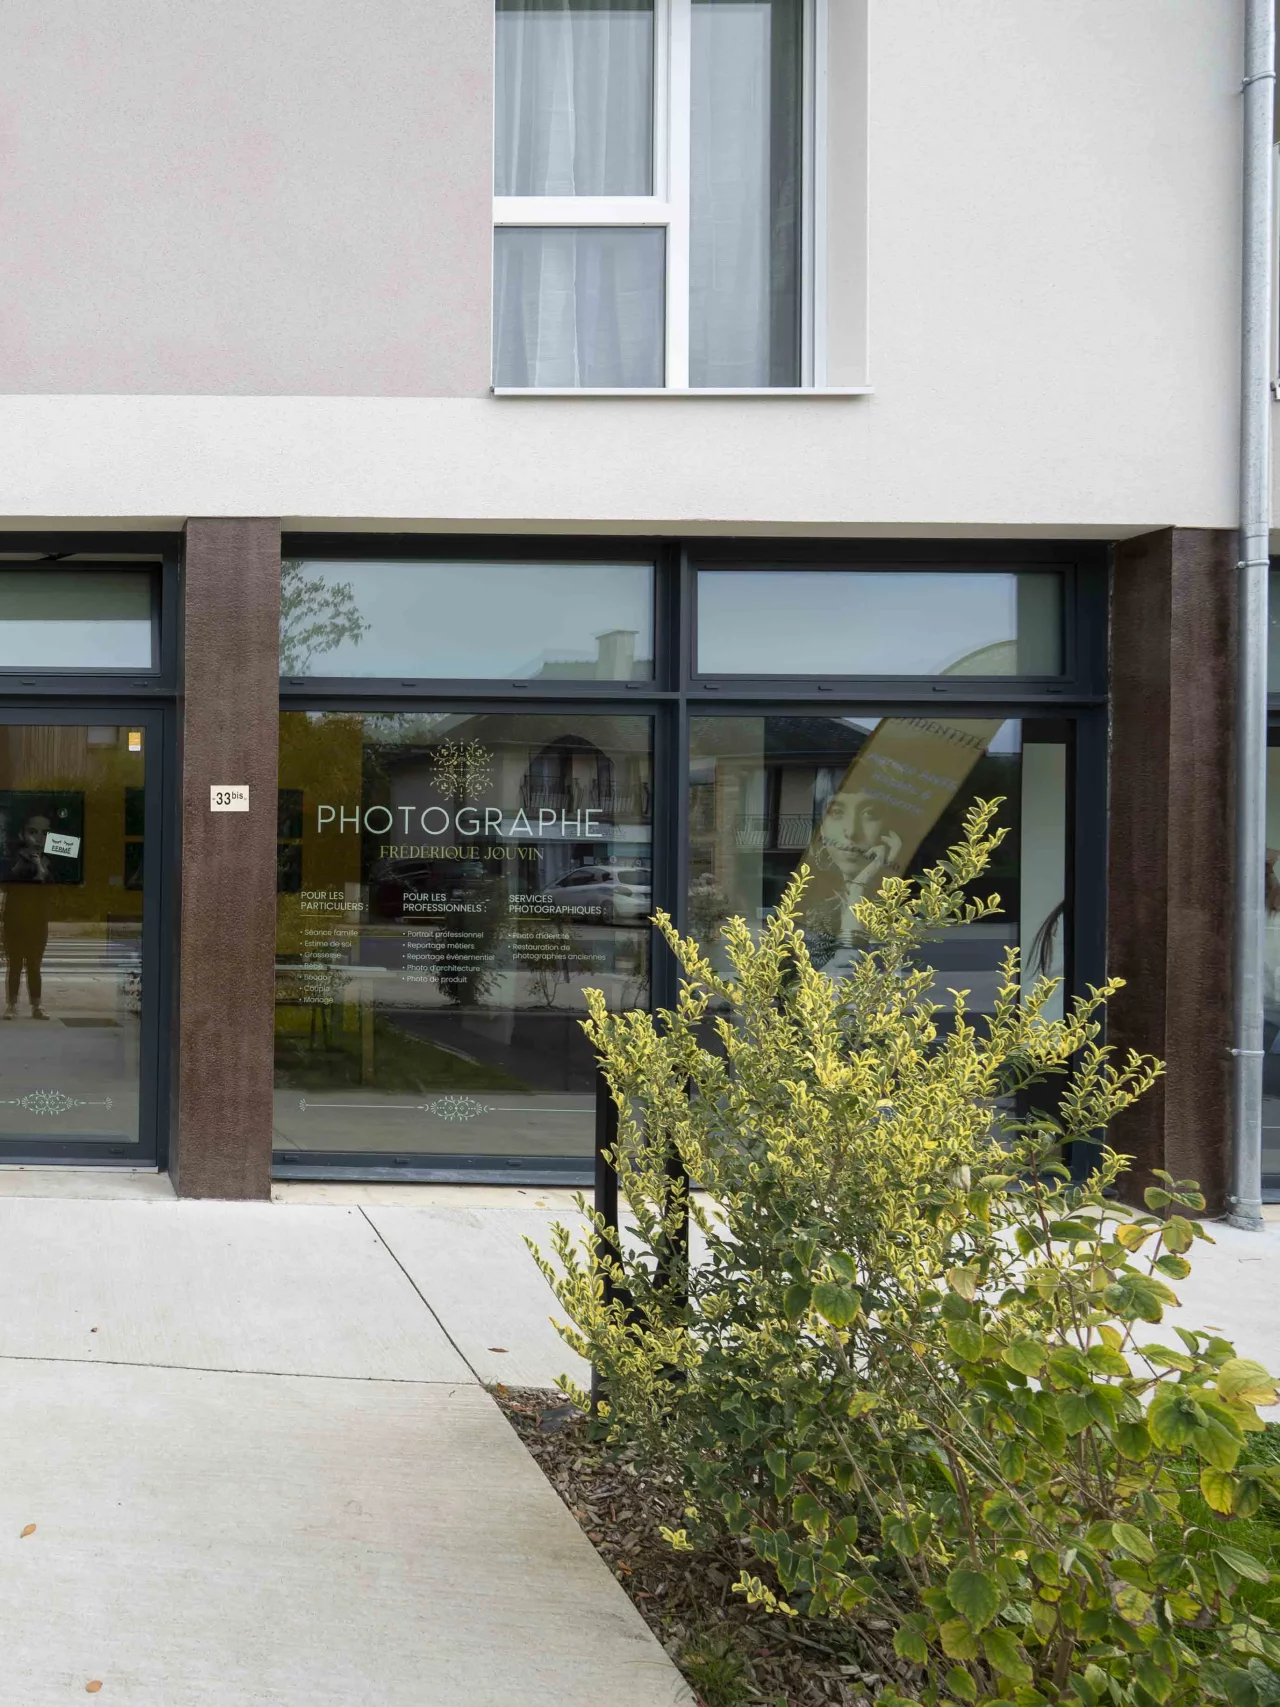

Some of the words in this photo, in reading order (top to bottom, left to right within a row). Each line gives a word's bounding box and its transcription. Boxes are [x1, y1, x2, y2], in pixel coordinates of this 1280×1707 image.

[317, 805, 603, 837] PHOTOGRAPHE
[379, 844, 481, 862] FRÉDÉRIQUE
[483, 847, 545, 861] JOUVIN
[300, 891, 327, 900] POUR
[329, 891, 345, 900] LES
[403, 892, 429, 901] POUR
[431, 893, 447, 902] LES
[509, 894, 553, 903] SERVICES
[300, 902, 364, 911] PARTICULIERS
[403, 903, 482, 913] PROFESSIONNELS
[509, 905, 602, 915] PHOTOGRAPHIQUES
[435, 930, 484, 939] professionnel
[536, 932, 570, 940] d'identité
[407, 942, 446, 951] Reportage
[512, 943, 559, 951] Restauration
[407, 953, 445, 962] Reportage
[512, 953, 566, 962] photographies
[429, 975, 439, 983] de
[440, 976, 467, 985] produit
[303, 985, 330, 993] Couple
